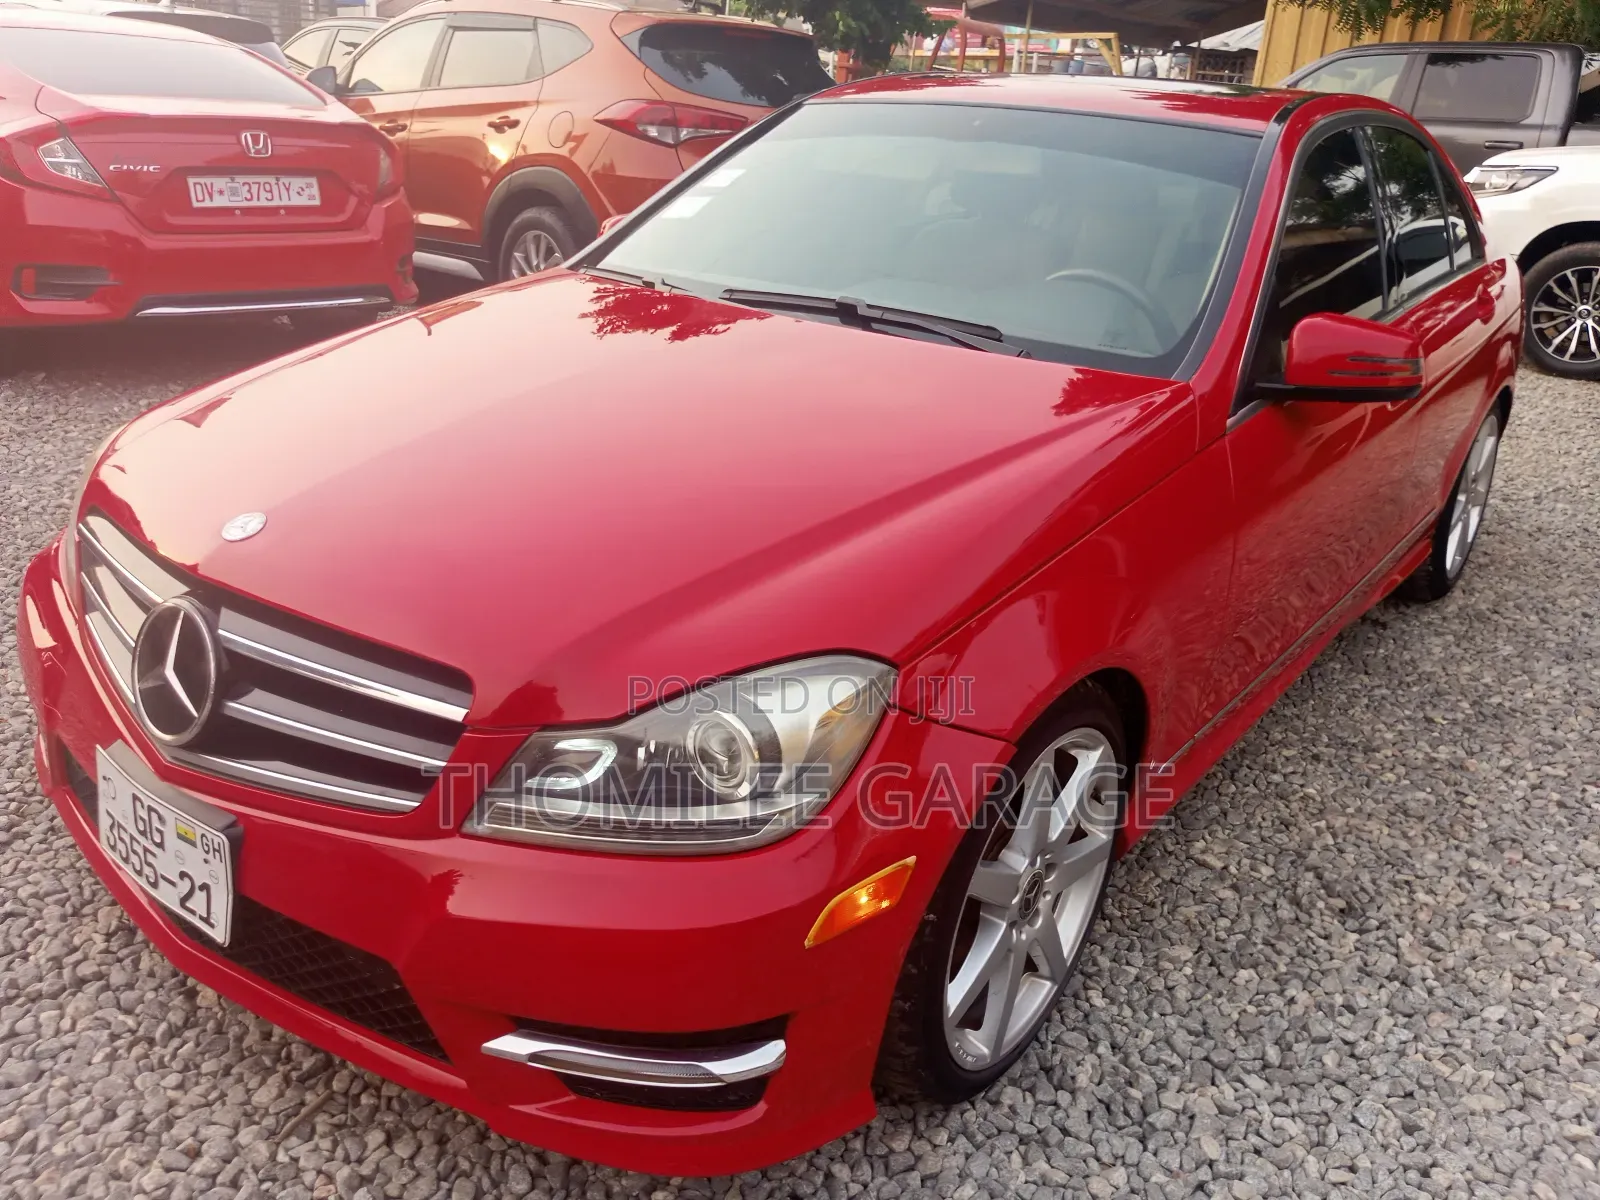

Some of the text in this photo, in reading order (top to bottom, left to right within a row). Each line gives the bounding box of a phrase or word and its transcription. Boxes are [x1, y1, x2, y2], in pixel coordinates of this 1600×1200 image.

[109, 164, 161, 173] CIVIC
[193, 182, 215, 203] DV
[132, 792, 166, 852] GG
[200, 832, 224, 864] GH
[105, 808, 216, 930] 3555-21
